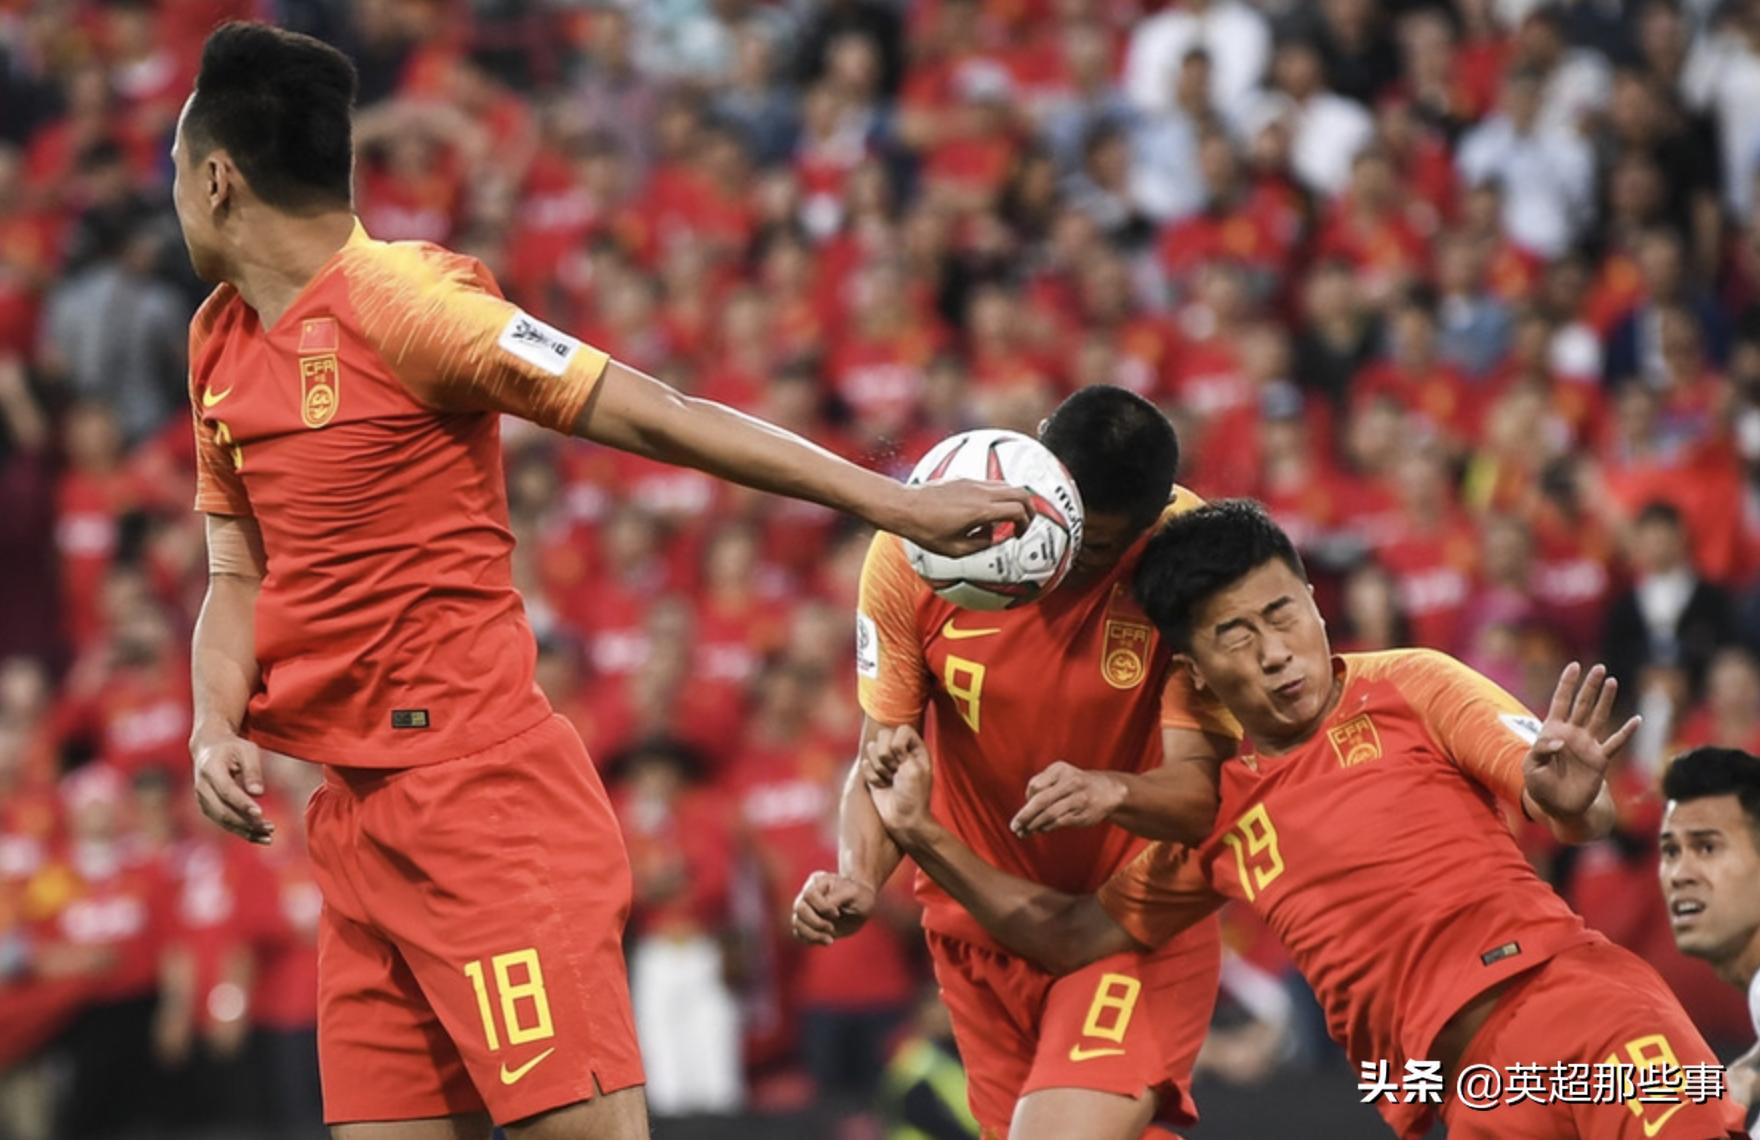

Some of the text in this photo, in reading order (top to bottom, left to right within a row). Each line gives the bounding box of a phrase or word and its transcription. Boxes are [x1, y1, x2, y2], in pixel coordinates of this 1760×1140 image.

[1110, 625, 1147, 642] CFA
[1333, 718, 1369, 744] CFA
[1222, 802, 1285, 902] 19
[464, 948, 555, 1051] 18
[1082, 973, 1141, 1043] 8
